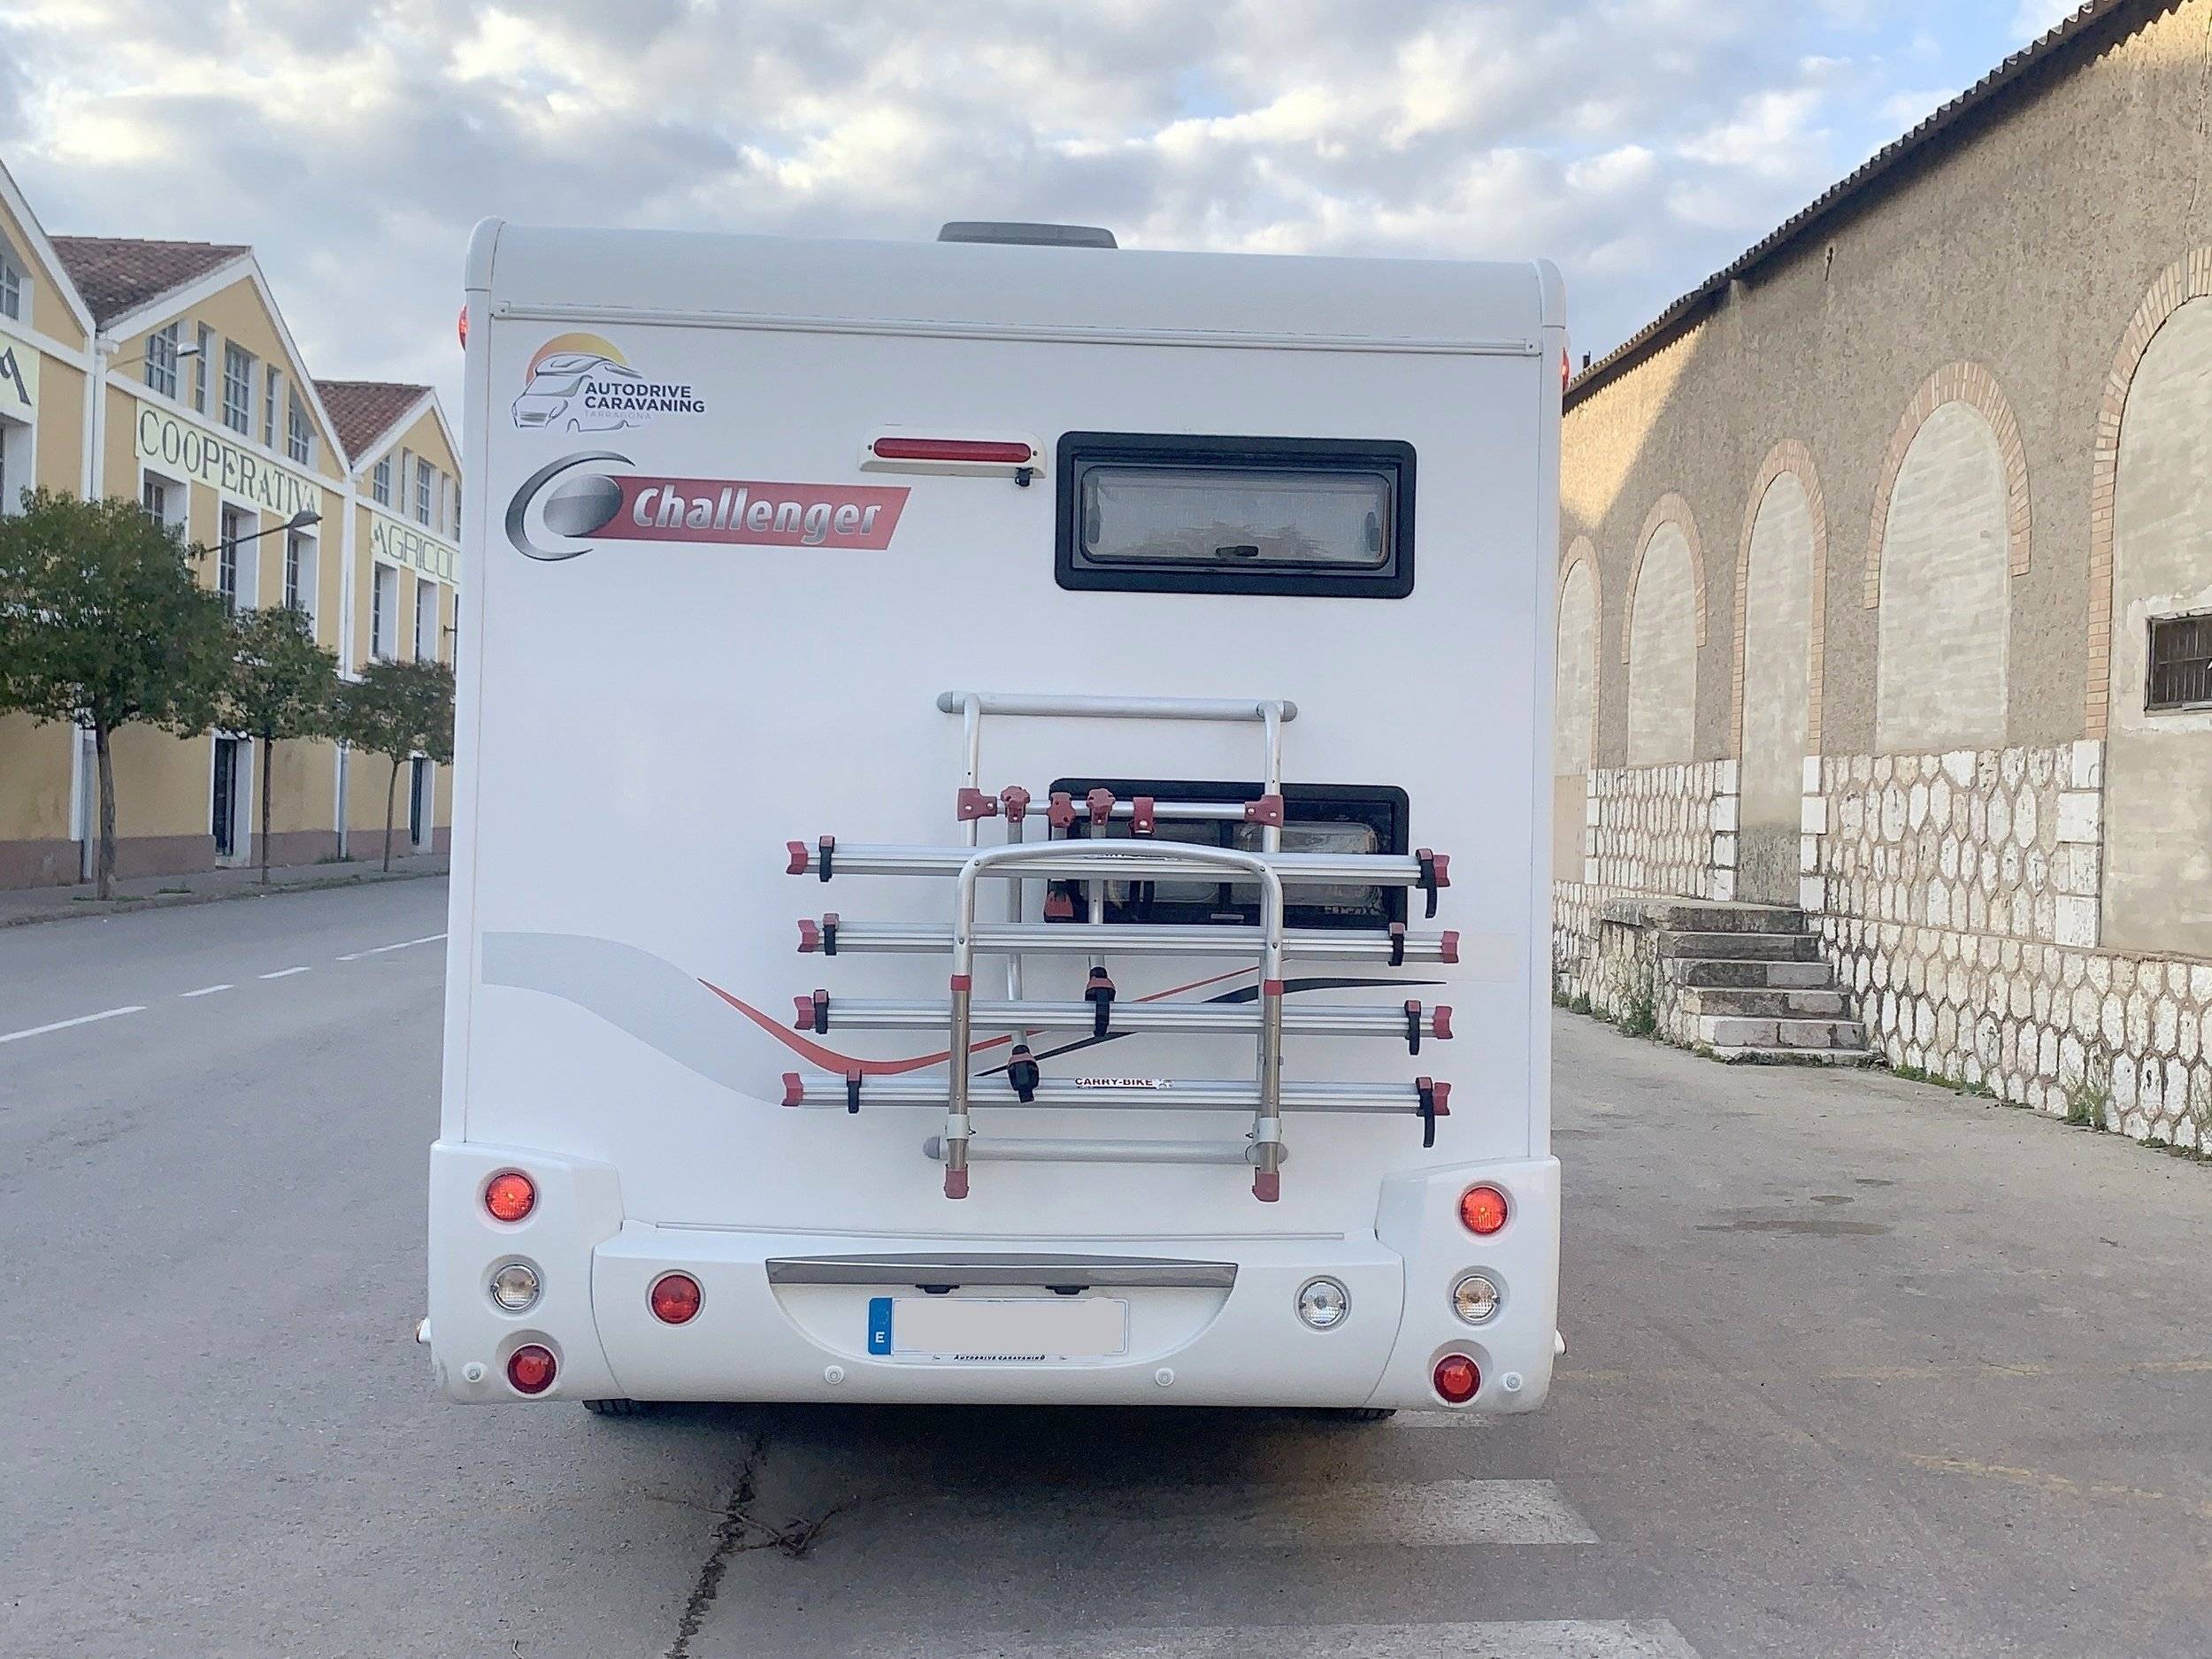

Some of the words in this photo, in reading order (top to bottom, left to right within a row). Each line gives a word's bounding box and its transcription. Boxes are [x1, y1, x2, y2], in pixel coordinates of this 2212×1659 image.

[585, 382, 692, 399] AUTODRIVE
[584, 396, 705, 413] CARAVANING
[139, 409, 317, 515] COOPERATIVA
[632, 483, 883, 545] Challenger
[1075, 1078, 1153, 1087] CARRY-BIKE
[875, 1331, 885, 1343] E
